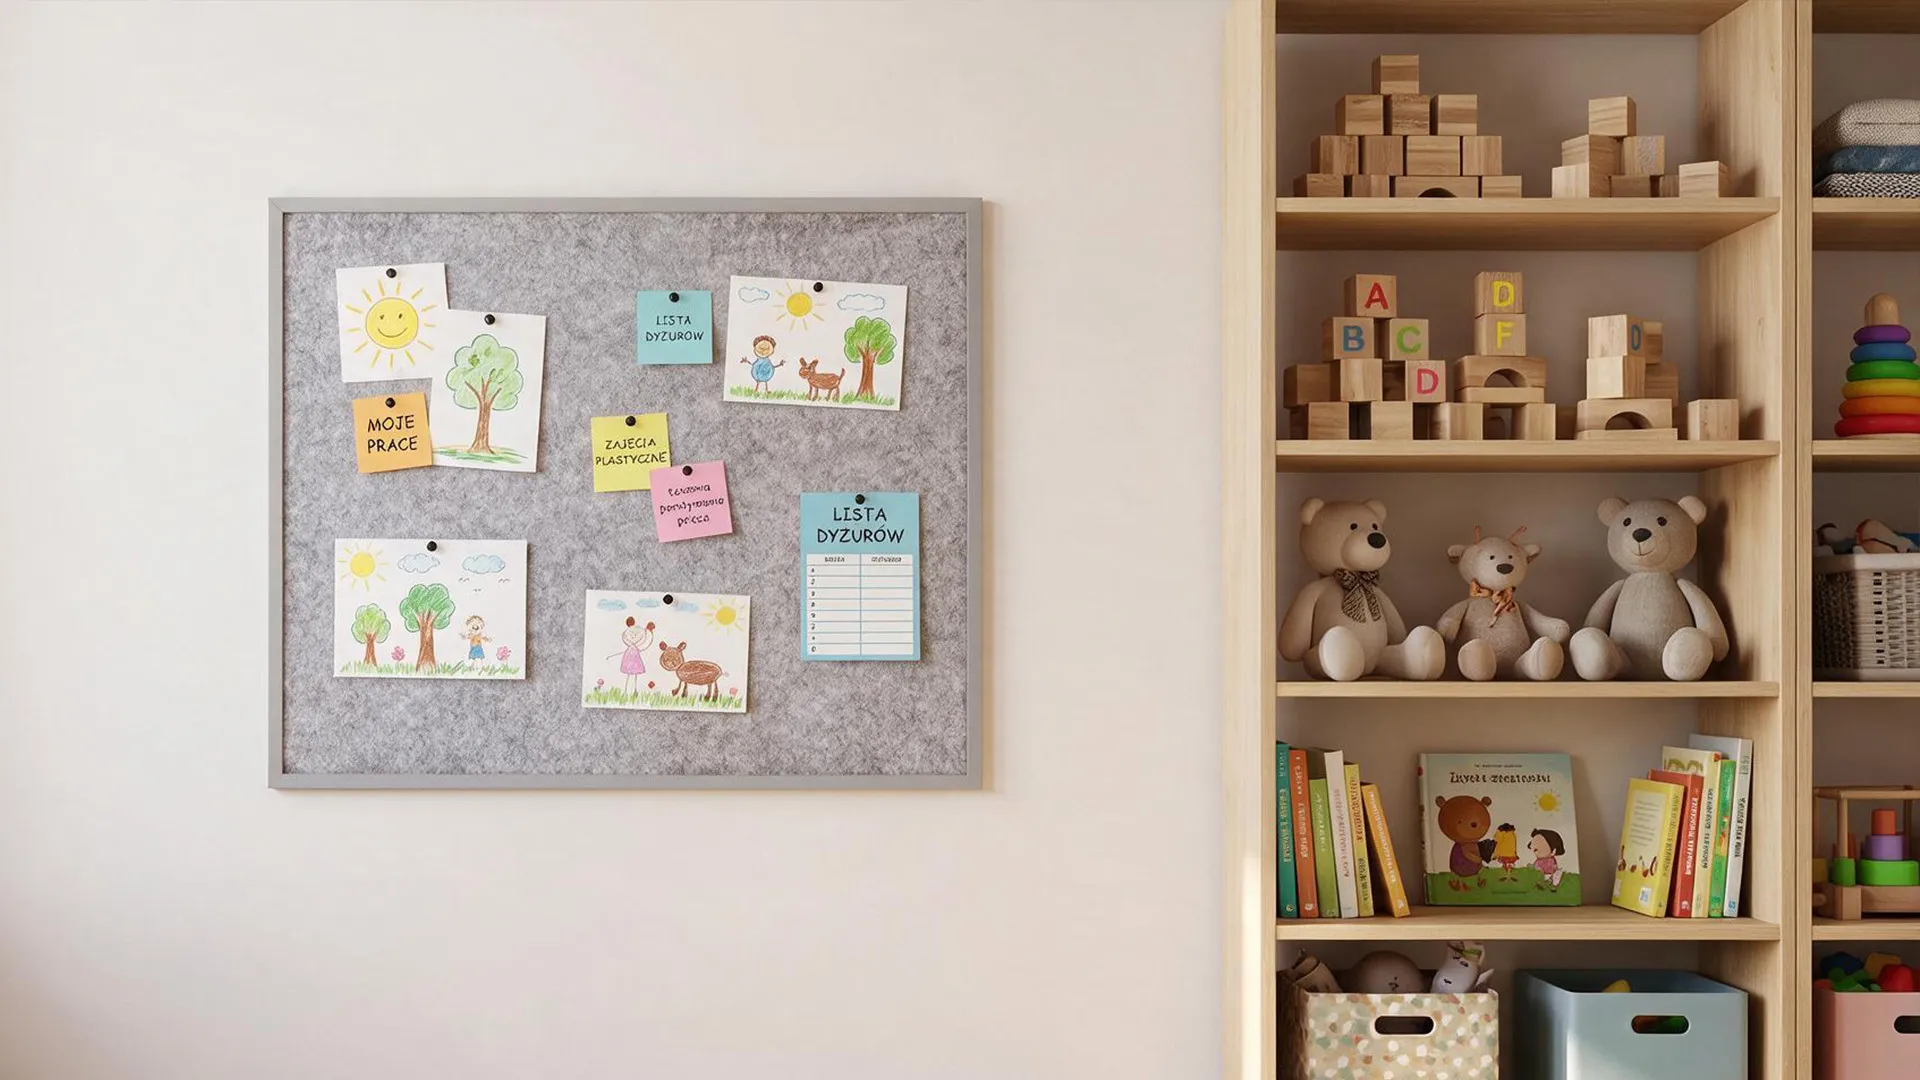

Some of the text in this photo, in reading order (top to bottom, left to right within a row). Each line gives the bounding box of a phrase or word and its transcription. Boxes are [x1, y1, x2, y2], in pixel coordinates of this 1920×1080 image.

[1364, 282, 1389, 310] A
[1492, 280, 1515, 307] D
[656, 315, 692, 326] LISTA
[1342, 325, 1365, 352] B
[1396, 325, 1422, 354] C
[1496, 321, 1516, 349] F
[1416, 368, 1439, 395] D
[367, 414, 415, 433] MOJE
[367, 435, 418, 454] PRACE
[595, 451, 667, 466] PLASTYCZNE
[833, 507, 887, 521] LISTA
